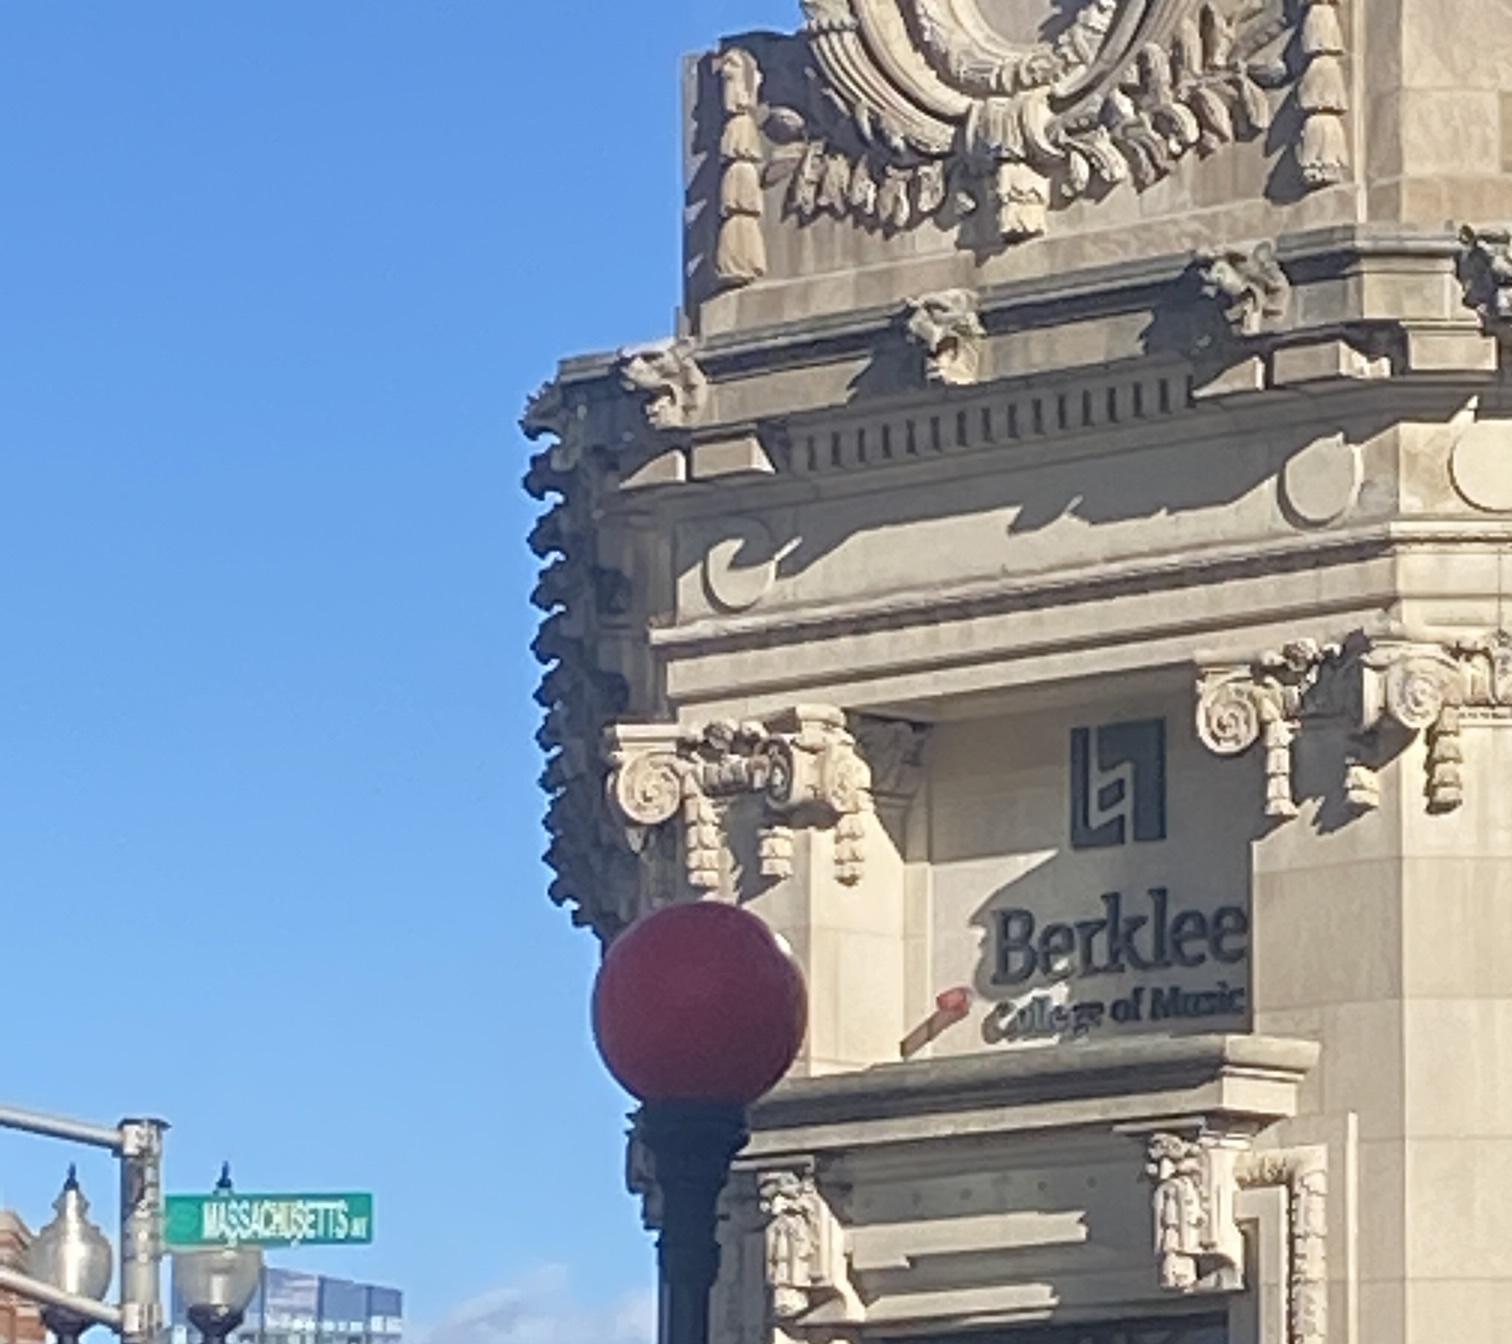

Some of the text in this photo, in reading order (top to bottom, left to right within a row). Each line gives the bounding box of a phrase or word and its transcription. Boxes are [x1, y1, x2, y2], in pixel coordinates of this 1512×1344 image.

[991, 887, 1248, 984] Berklee
[1110, 987, 1145, 1023] of
[1150, 980, 1245, 1021] Music
[203, 1199, 348, 1239] MASSACHUSETTS
